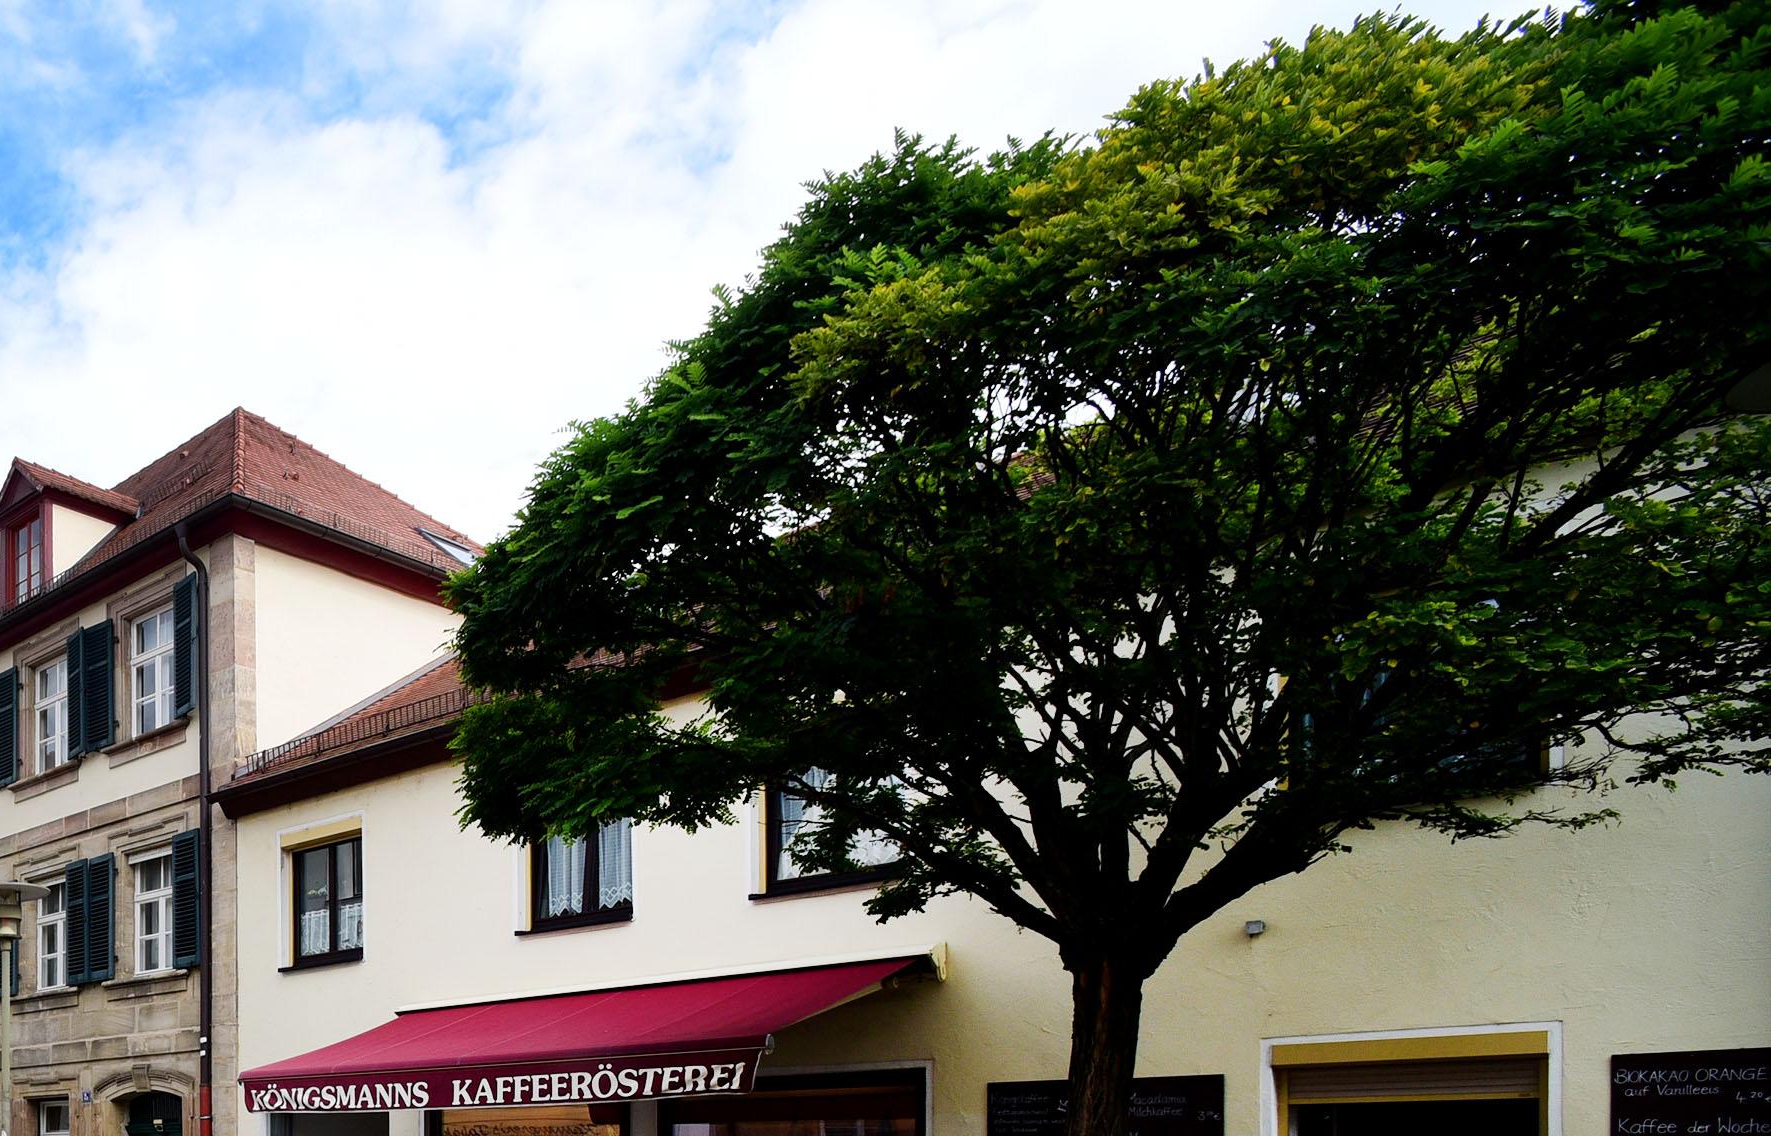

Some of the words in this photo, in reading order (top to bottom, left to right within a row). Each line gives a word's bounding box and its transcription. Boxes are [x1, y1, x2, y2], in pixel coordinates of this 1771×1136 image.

[1695, 1067, 1768, 1082] ORANGE
[251, 1083, 429, 1111] KÖNIGSMANNS
[451, 1063, 746, 1106] KAFFEERÖSTEREI
[1624, 1085, 1651, 1097] auf
[1618, 1118, 1677, 1134] Kaffee
[1687, 1120, 1711, 1134] der
[1718, 1116, 1771, 1134] Woche
